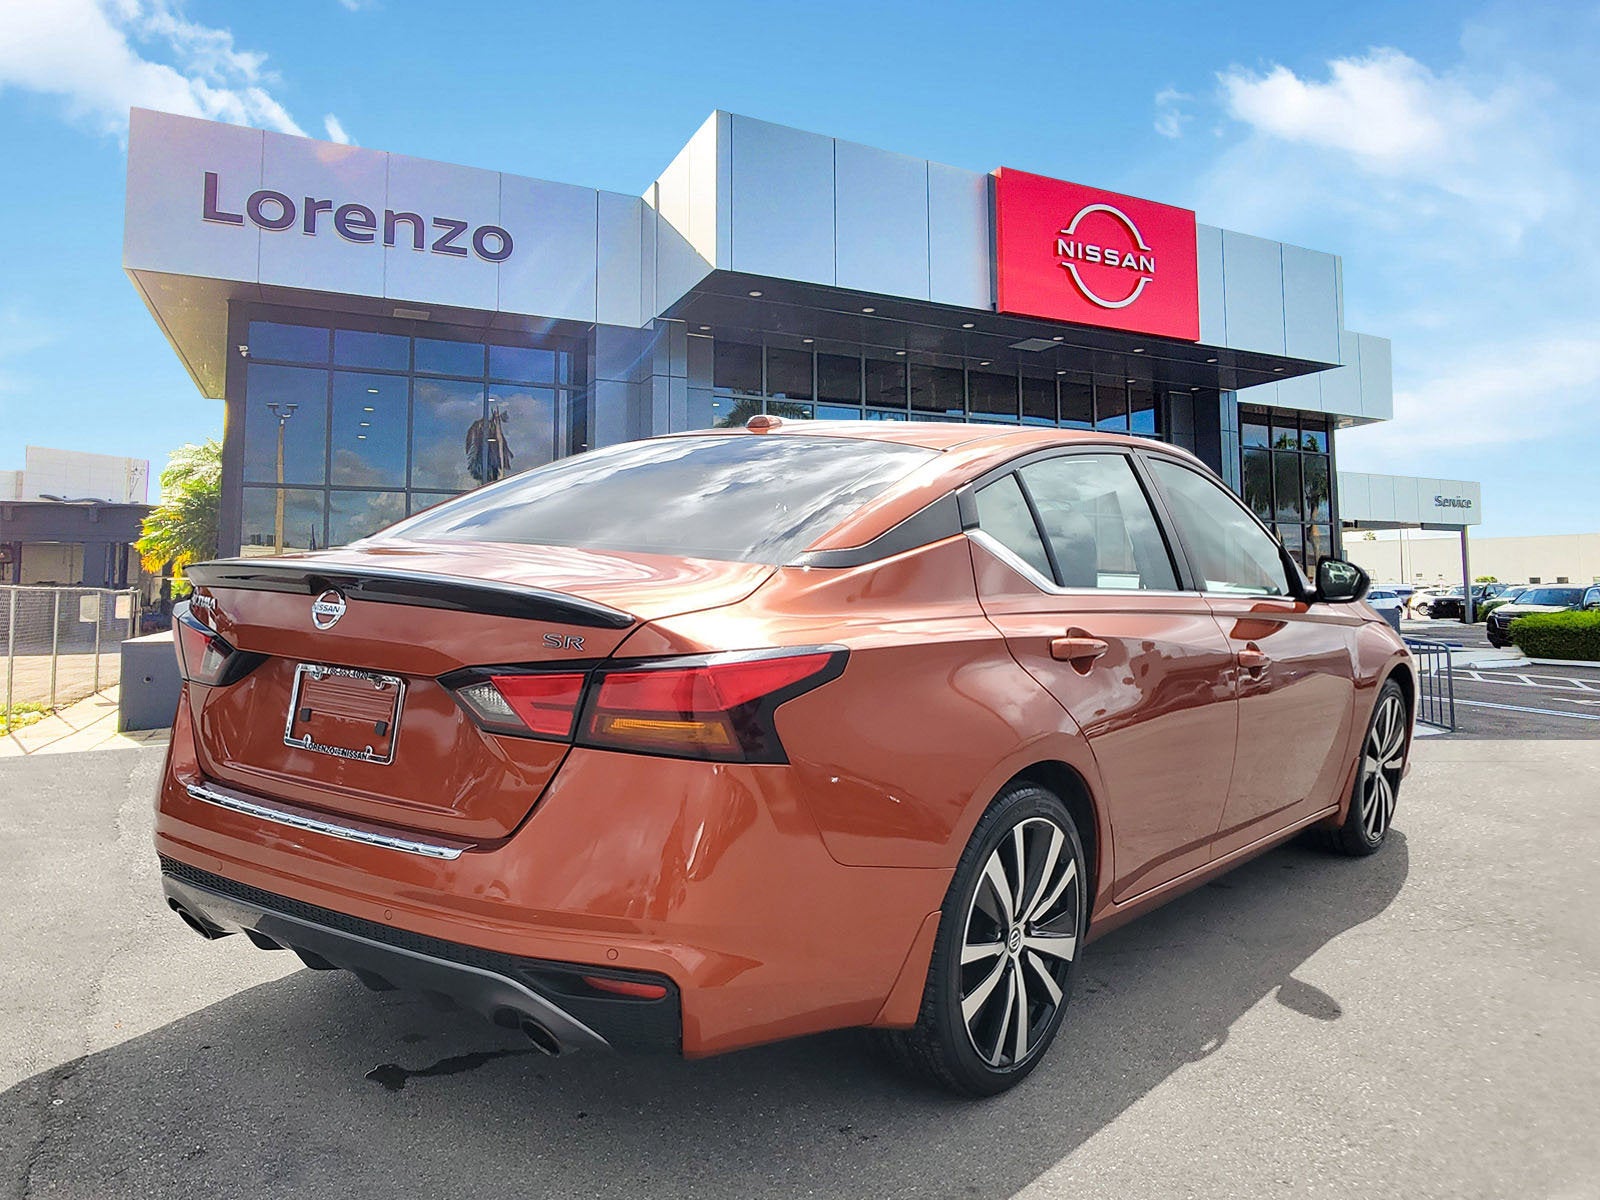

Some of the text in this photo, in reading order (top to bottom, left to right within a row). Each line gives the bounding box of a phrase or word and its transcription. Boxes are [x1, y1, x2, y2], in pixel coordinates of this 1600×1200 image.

[202, 171, 514, 262] Lorenzo
[1057, 238, 1155, 273] NISSAN
[1434, 495, 1472, 508] Service
[542, 633, 585, 651] SR
[341, 748, 368, 760] NISSAN
